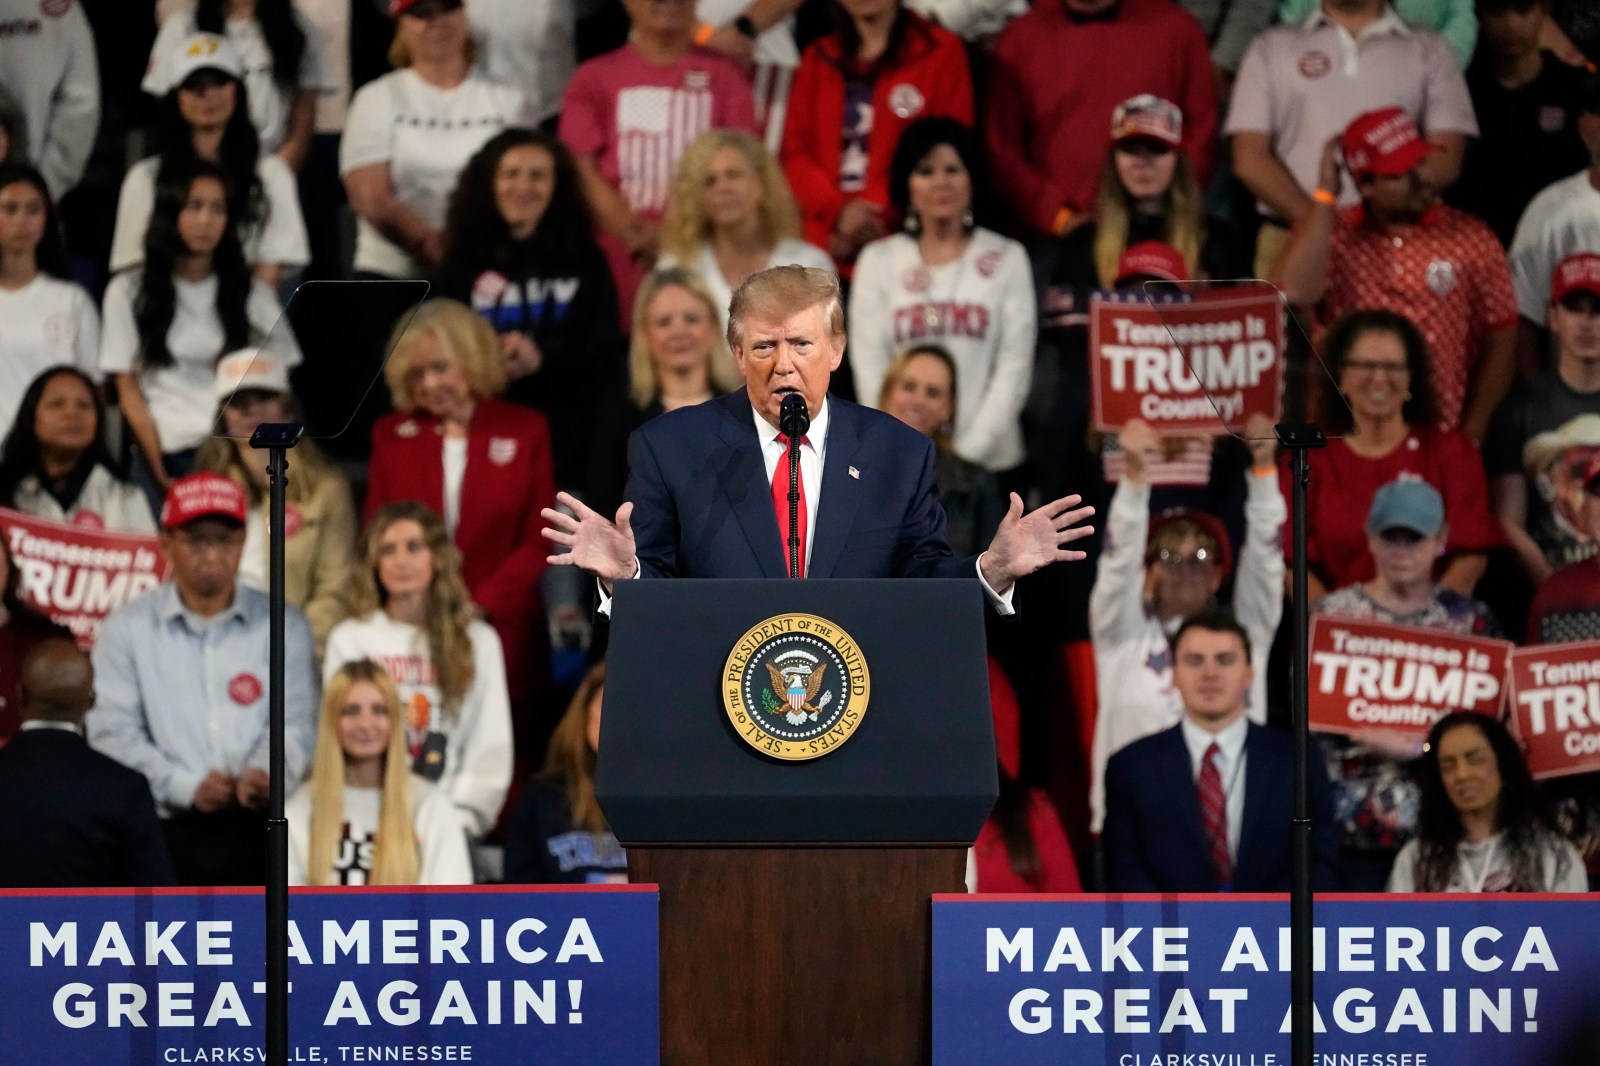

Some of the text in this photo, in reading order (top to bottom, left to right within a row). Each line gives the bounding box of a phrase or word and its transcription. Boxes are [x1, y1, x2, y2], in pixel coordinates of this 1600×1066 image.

[1114, 318, 1243, 345] Tennessee
[1101, 339, 1276, 394] TRUMP
[1140, 390, 1244, 422] Country!
[7, 526, 133, 570] Tennessee
[797, 620, 812, 630] OF
[814, 623, 833, 638] THE
[727, 618, 794, 683] PRESIDENT
[835, 635, 866, 697] UNITED
[1330, 629, 1463, 667] Tennessee
[729, 688, 740, 709] THE
[1312, 651, 1500, 711] TRUMP
[734, 710, 747, 724] OF
[745, 721, 783, 753] SEAL
[809, 709, 859, 753] STATES
[29, 920, 233, 967] MAKE
[986, 927, 1189, 972] MAKE
[323, 979, 583, 1026] AGAIN!
[1008, 988, 1248, 1035] GREAT
[164, 1045, 472, 1064] CLARKSVLE, TENNESSEE
[1312, 1054, 1427, 1066] ENNESSEE
